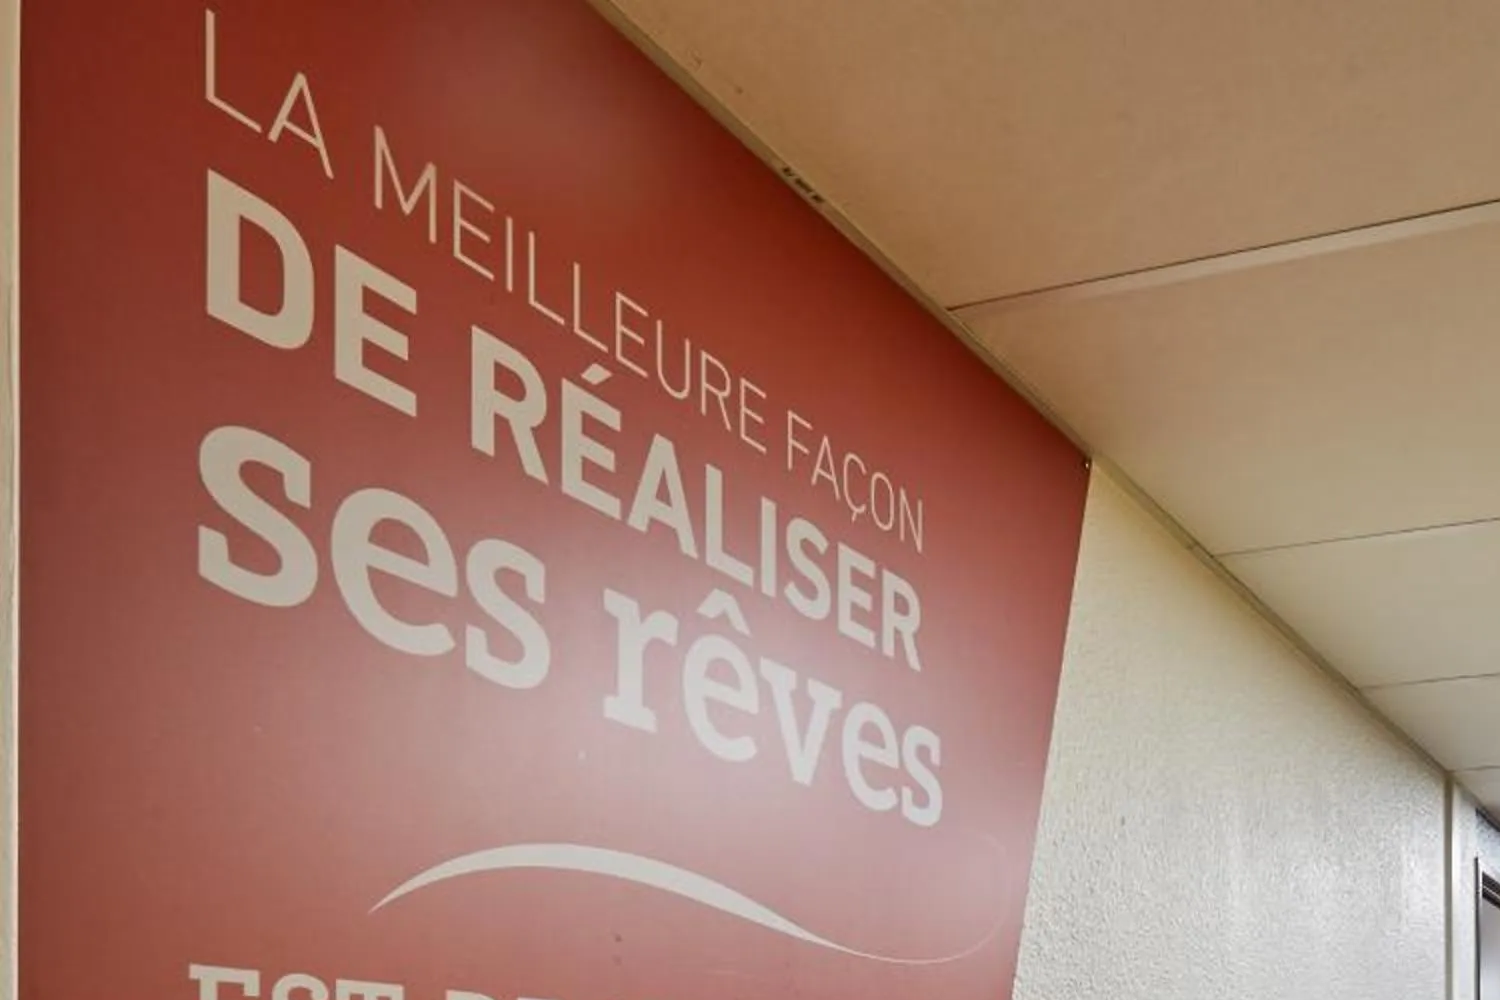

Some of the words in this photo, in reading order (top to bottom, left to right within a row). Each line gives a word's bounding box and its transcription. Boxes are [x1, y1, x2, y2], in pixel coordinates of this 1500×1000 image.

[205, 8, 333, 178] LA
[374, 125, 767, 454] MEILLEURE
[786, 409, 924, 554] FAÇON
[206, 168, 417, 417] DE
[471, 363, 922, 672] RÉALISER
[602, 588, 944, 827] rêves
